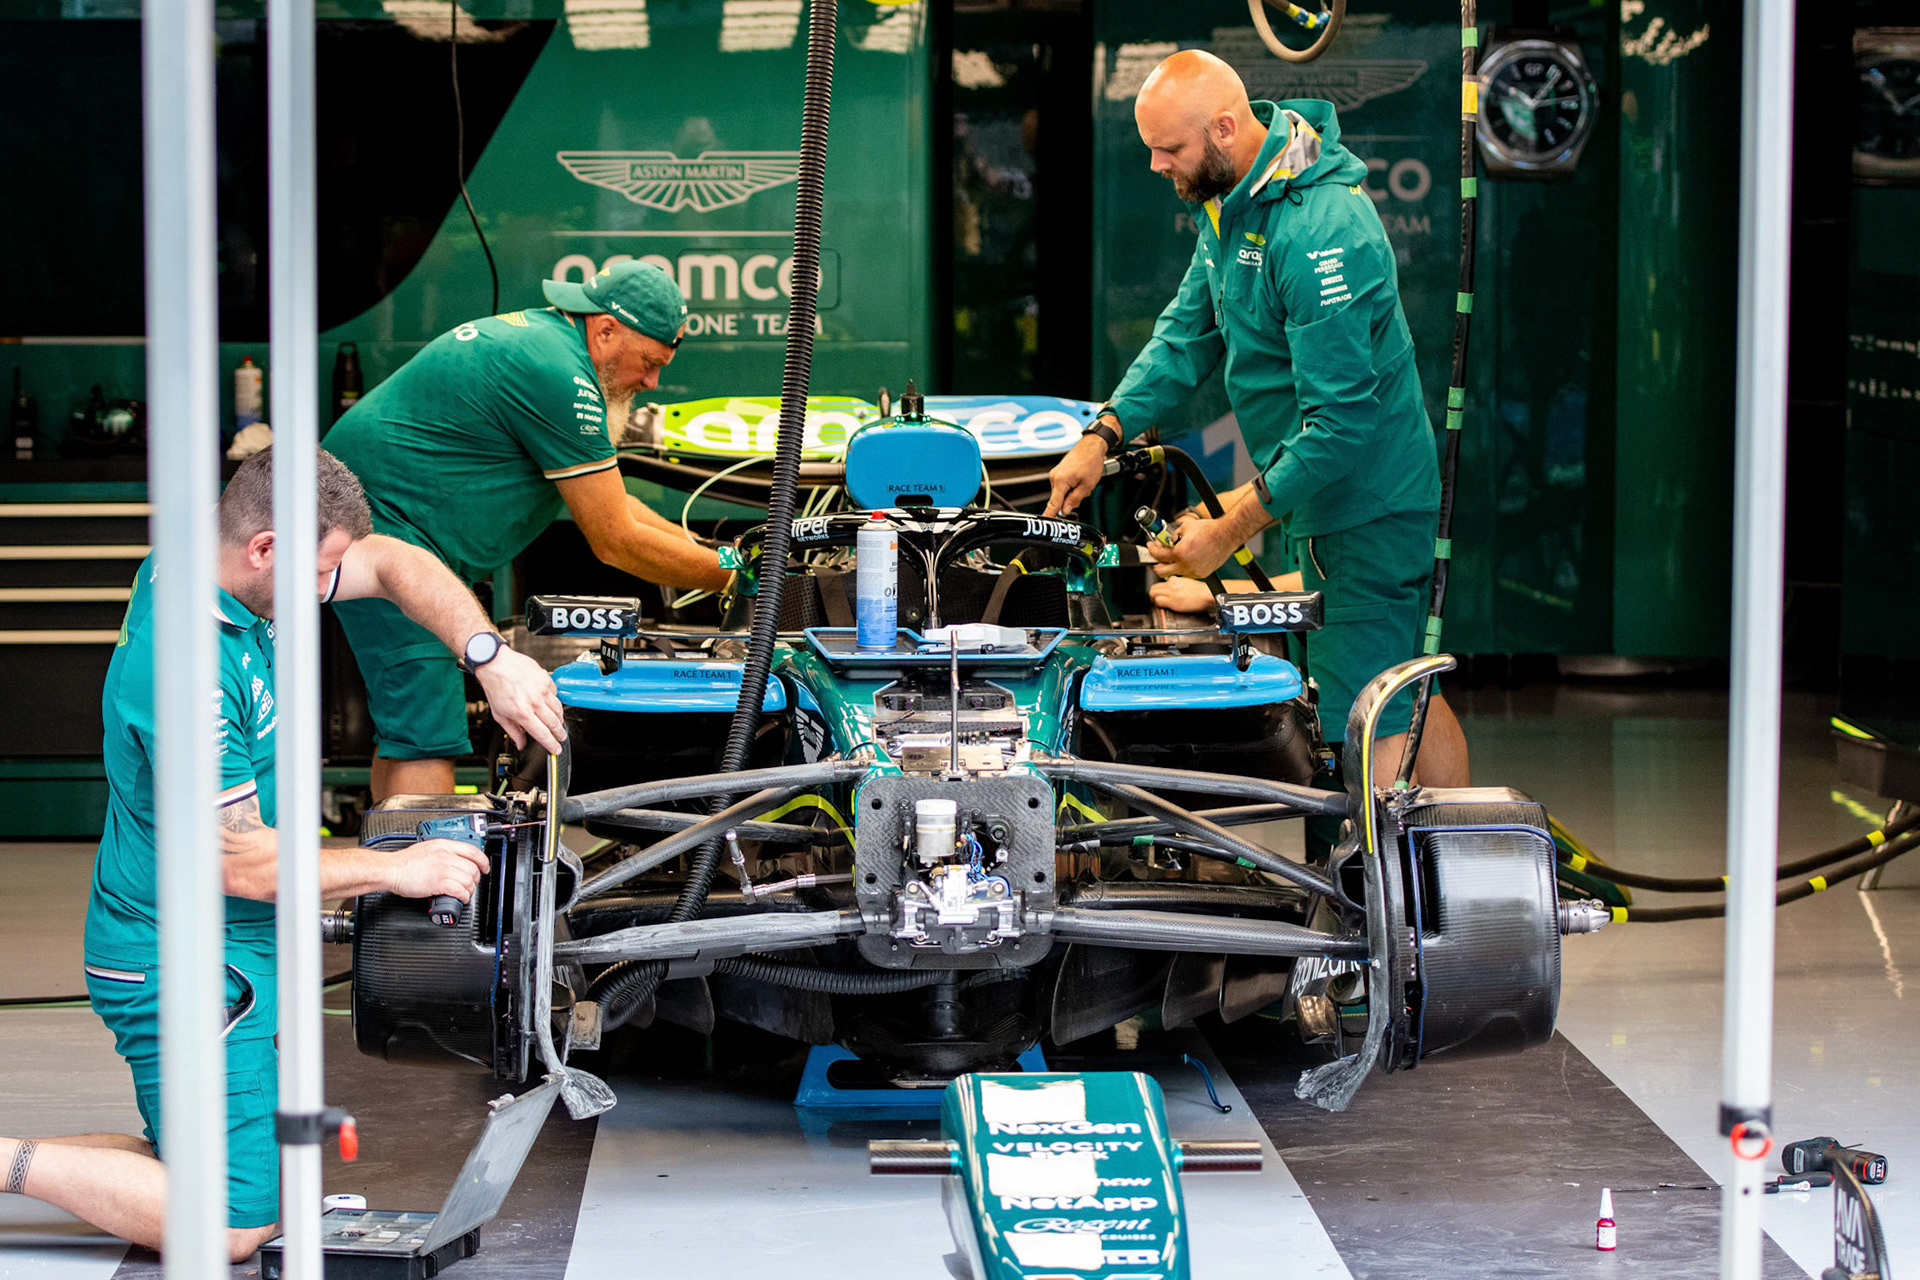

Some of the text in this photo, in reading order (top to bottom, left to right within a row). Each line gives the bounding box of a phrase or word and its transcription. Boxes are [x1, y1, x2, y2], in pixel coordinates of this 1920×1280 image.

[633, 166, 742, 178] ASTON MARTIN
[686, 410, 1084, 451] araco
[552, 607, 623, 630] BOSS
[1233, 602, 1303, 626] BOSS
[601, 645, 619, 661] OAKL
[673, 670, 698, 678] RACE
[700, 670, 726, 679] TEAM
[1117, 668, 1141, 677] RACE
[1143, 668, 1168, 676] TEAM
[989, 1121, 1142, 1135] NexGen
[992, 1141, 1143, 1152] VELOCITY
[1001, 1195, 1158, 1211] NetApp
